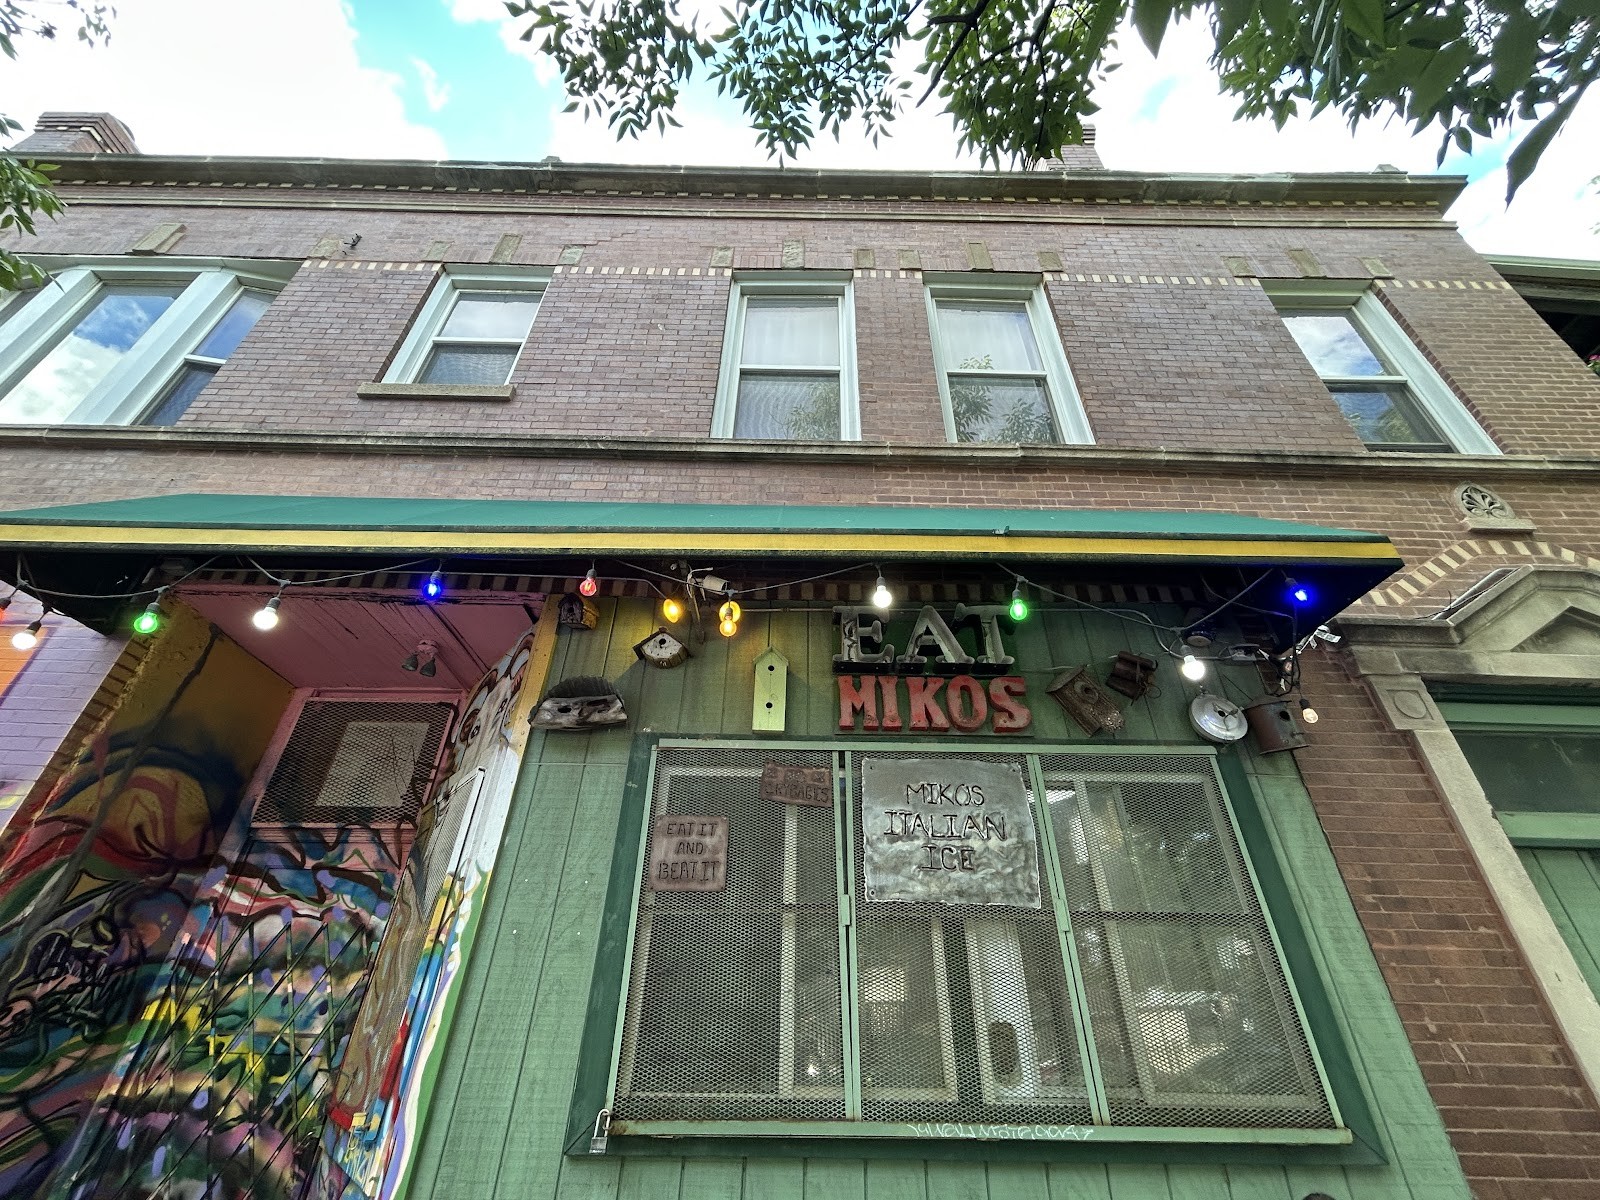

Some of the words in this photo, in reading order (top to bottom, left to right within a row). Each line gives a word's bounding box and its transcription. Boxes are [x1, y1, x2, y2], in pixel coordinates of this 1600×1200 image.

[832, 603, 1016, 671] EAT
[838, 675, 1031, 732] MIKOS
[905, 782, 985, 807] MIKOS
[665, 822, 694, 836] EAT
[697, 822, 718, 837] IT
[883, 810, 1007, 841] ITALIAN
[675, 841, 704, 855] AND
[920, 844, 976, 872] ICE
[657, 861, 698, 880] BEAT
[699, 860, 720, 881] IT
